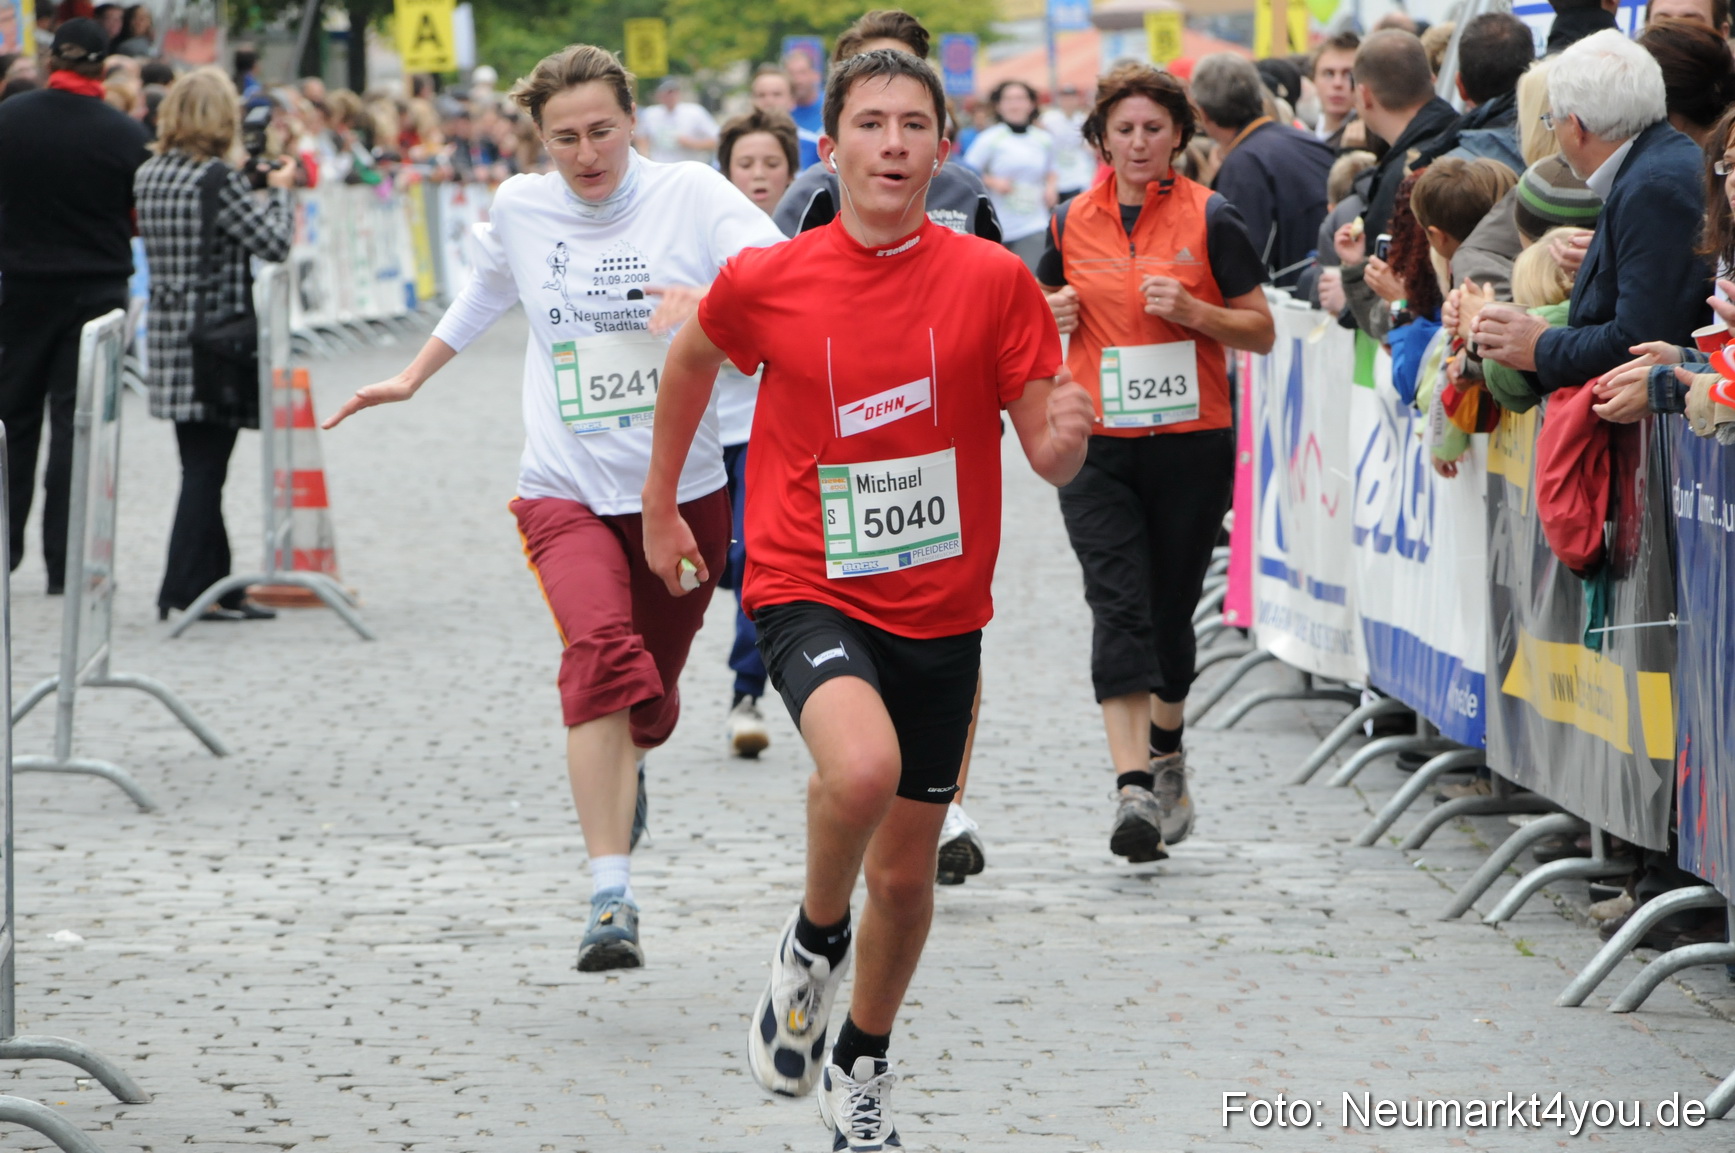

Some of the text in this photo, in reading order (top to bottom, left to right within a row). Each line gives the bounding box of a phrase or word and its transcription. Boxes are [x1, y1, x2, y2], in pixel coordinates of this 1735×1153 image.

[411, 12, 443, 50] A
[593, 273, 650, 286] 21.09.2008
[549, 307, 652, 325] 9. Neumarkter
[590, 368, 659, 402] 5241
[1128, 375, 1187, 400] 5243
[864, 395, 905, 421] DEHN
[856, 467, 922, 494] Michael
[827, 509, 836, 525] S
[864, 496, 945, 538] 5040
[912, 539, 959, 559] PFLEIDERER
[842, 560, 879, 571] BOCK
